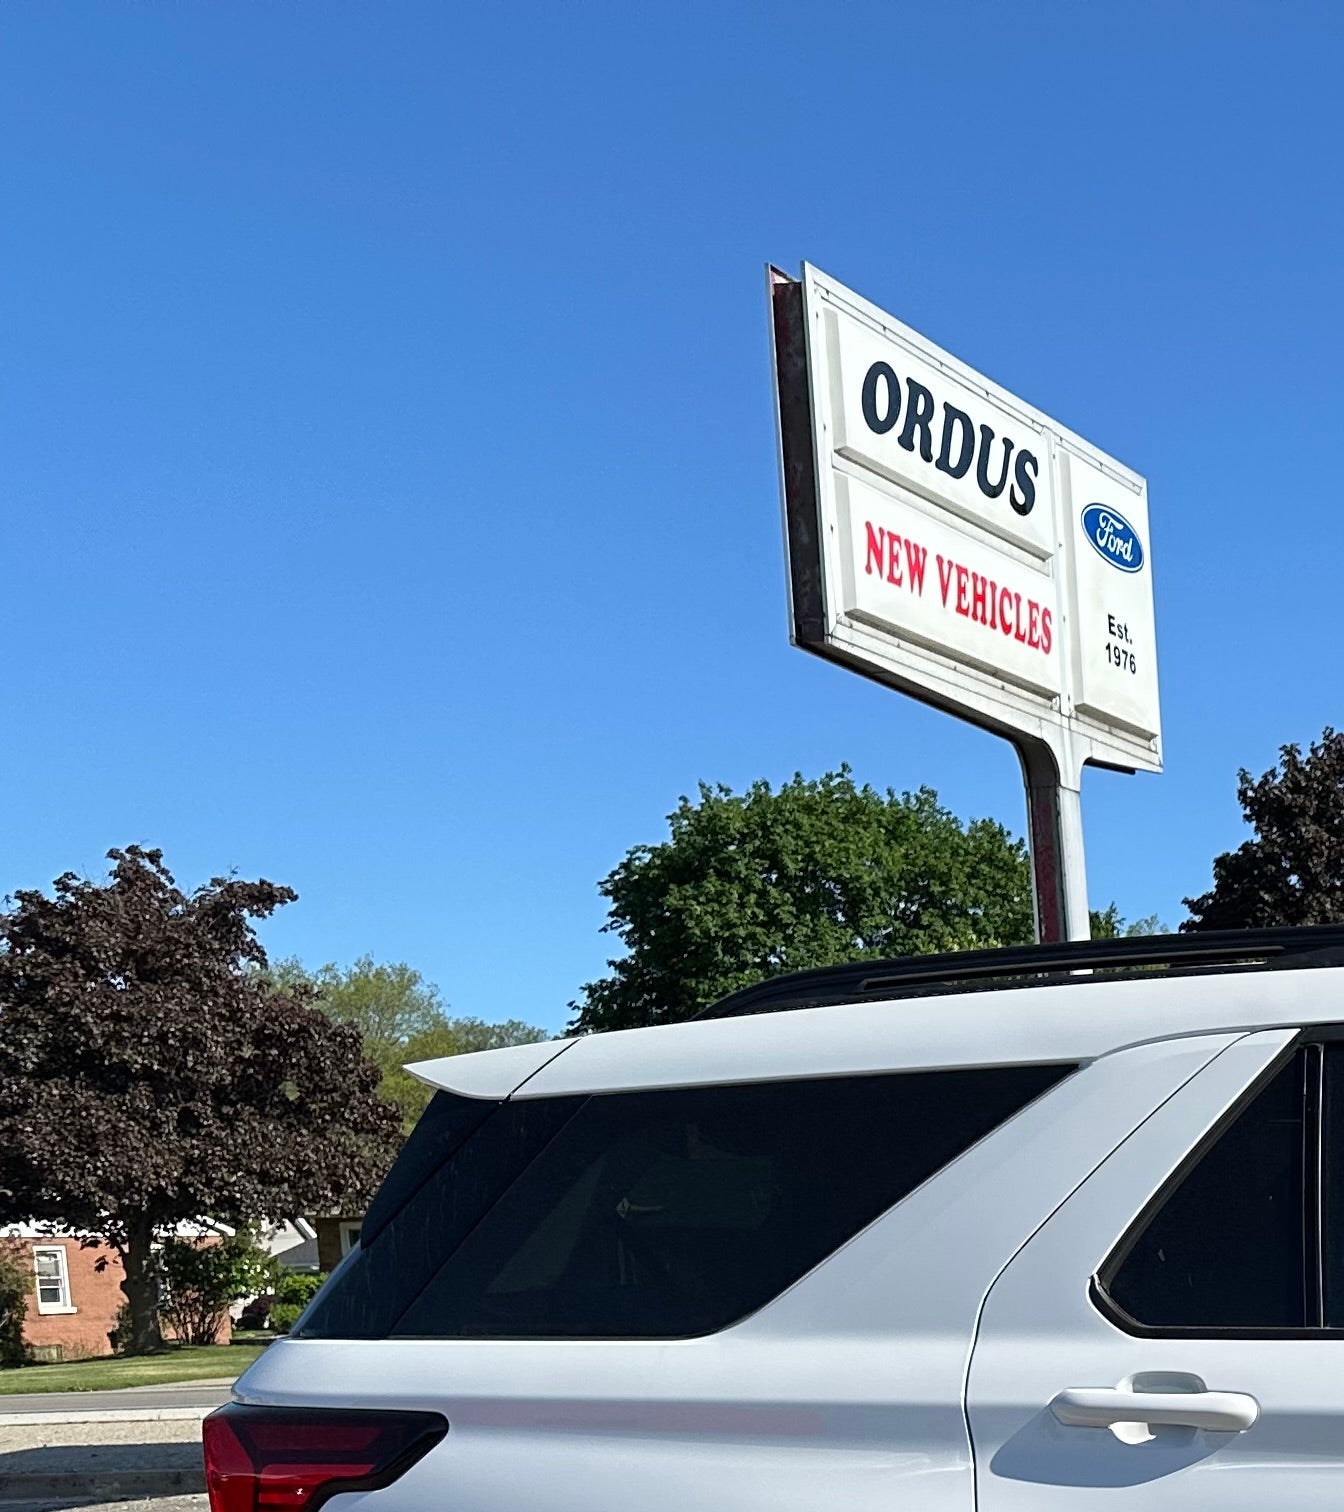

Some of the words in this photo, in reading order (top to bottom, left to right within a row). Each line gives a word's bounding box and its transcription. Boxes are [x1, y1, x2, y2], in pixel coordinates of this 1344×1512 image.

[861, 361, 1038, 516] ORDUS
[1096, 512, 1134, 563] Ford
[864, 520, 927, 598] NEW
[936, 553, 1053, 656] VEHICLES
[1107, 612, 1133, 645] Est.
[1104, 642, 1137, 675] 1976
